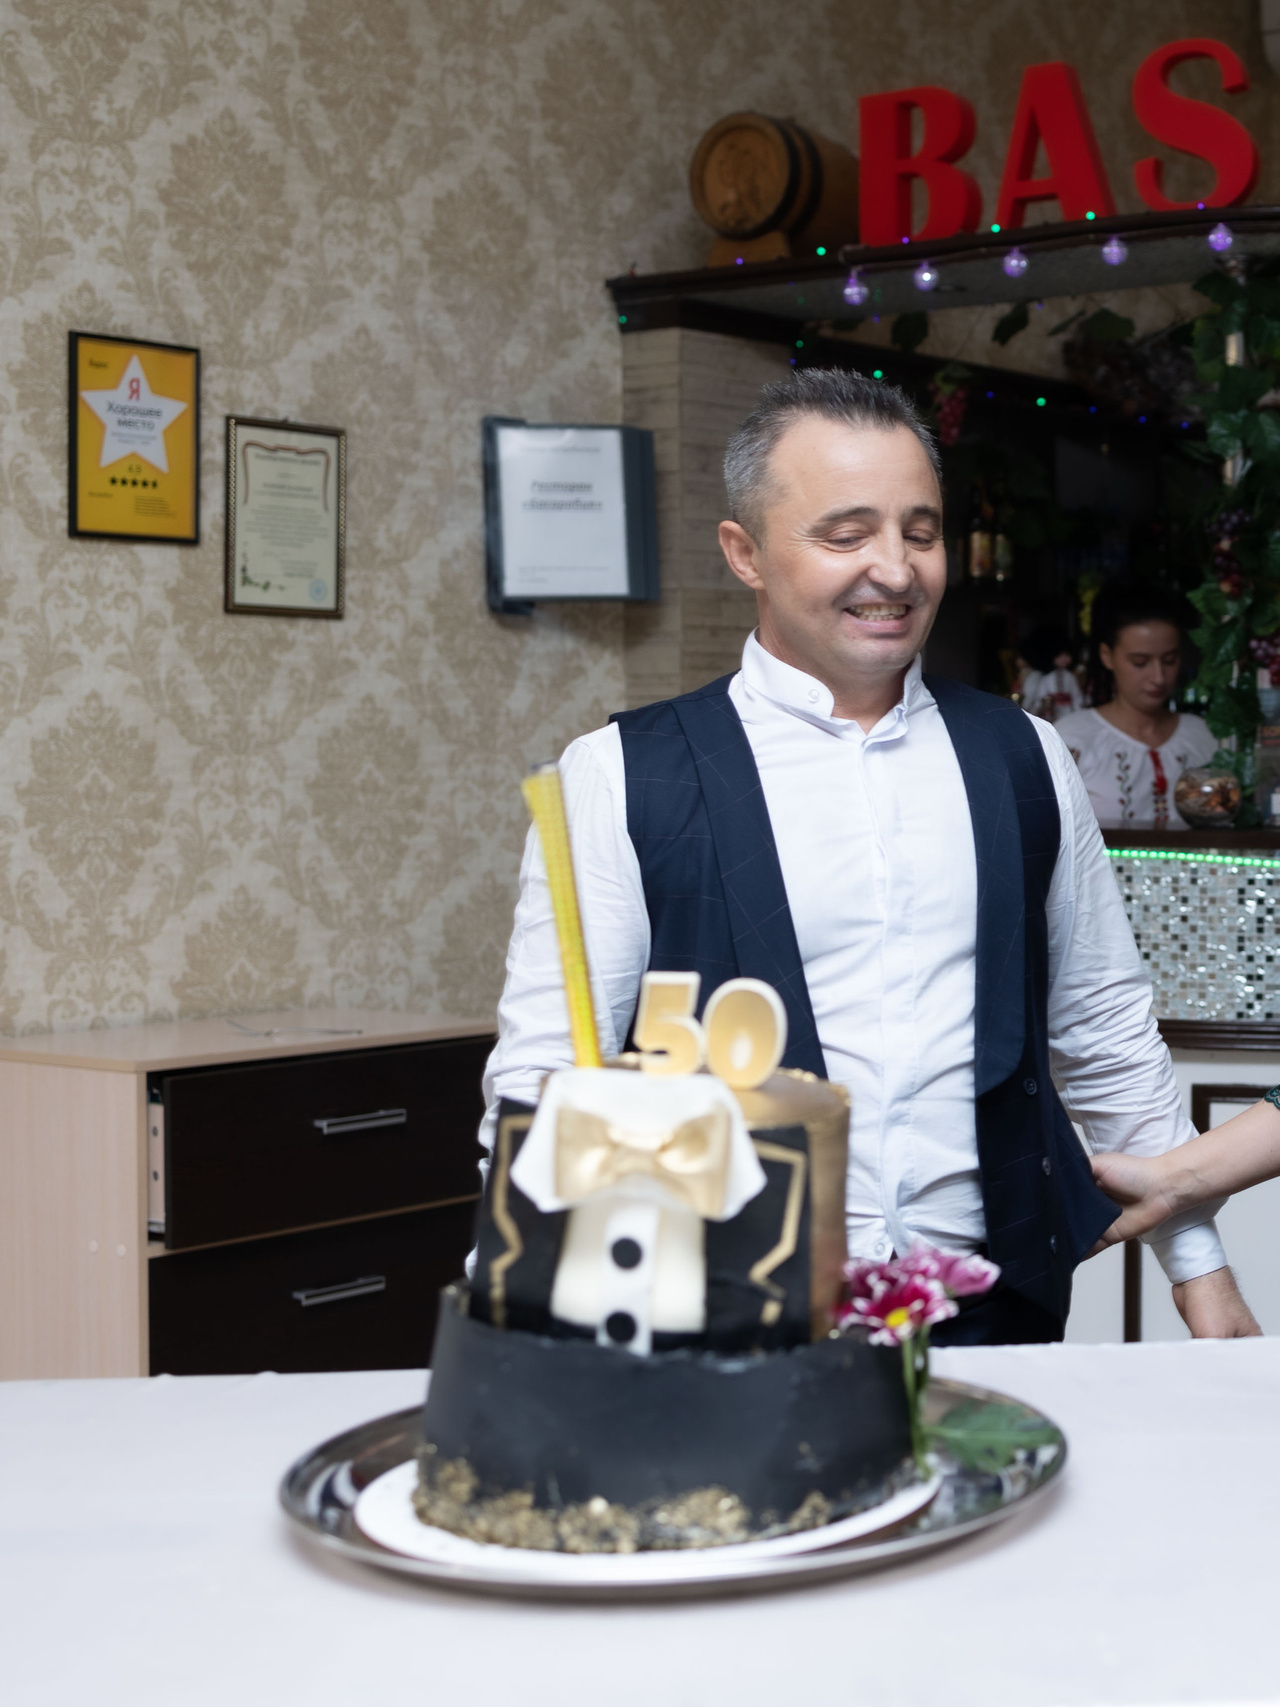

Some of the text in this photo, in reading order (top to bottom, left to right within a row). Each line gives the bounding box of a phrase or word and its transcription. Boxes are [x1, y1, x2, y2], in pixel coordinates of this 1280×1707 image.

[127, 376, 141, 401] Я
[106, 400, 163, 419] Хорошее
[116, 417, 156, 432] место
[632, 970, 789, 1091] 50
